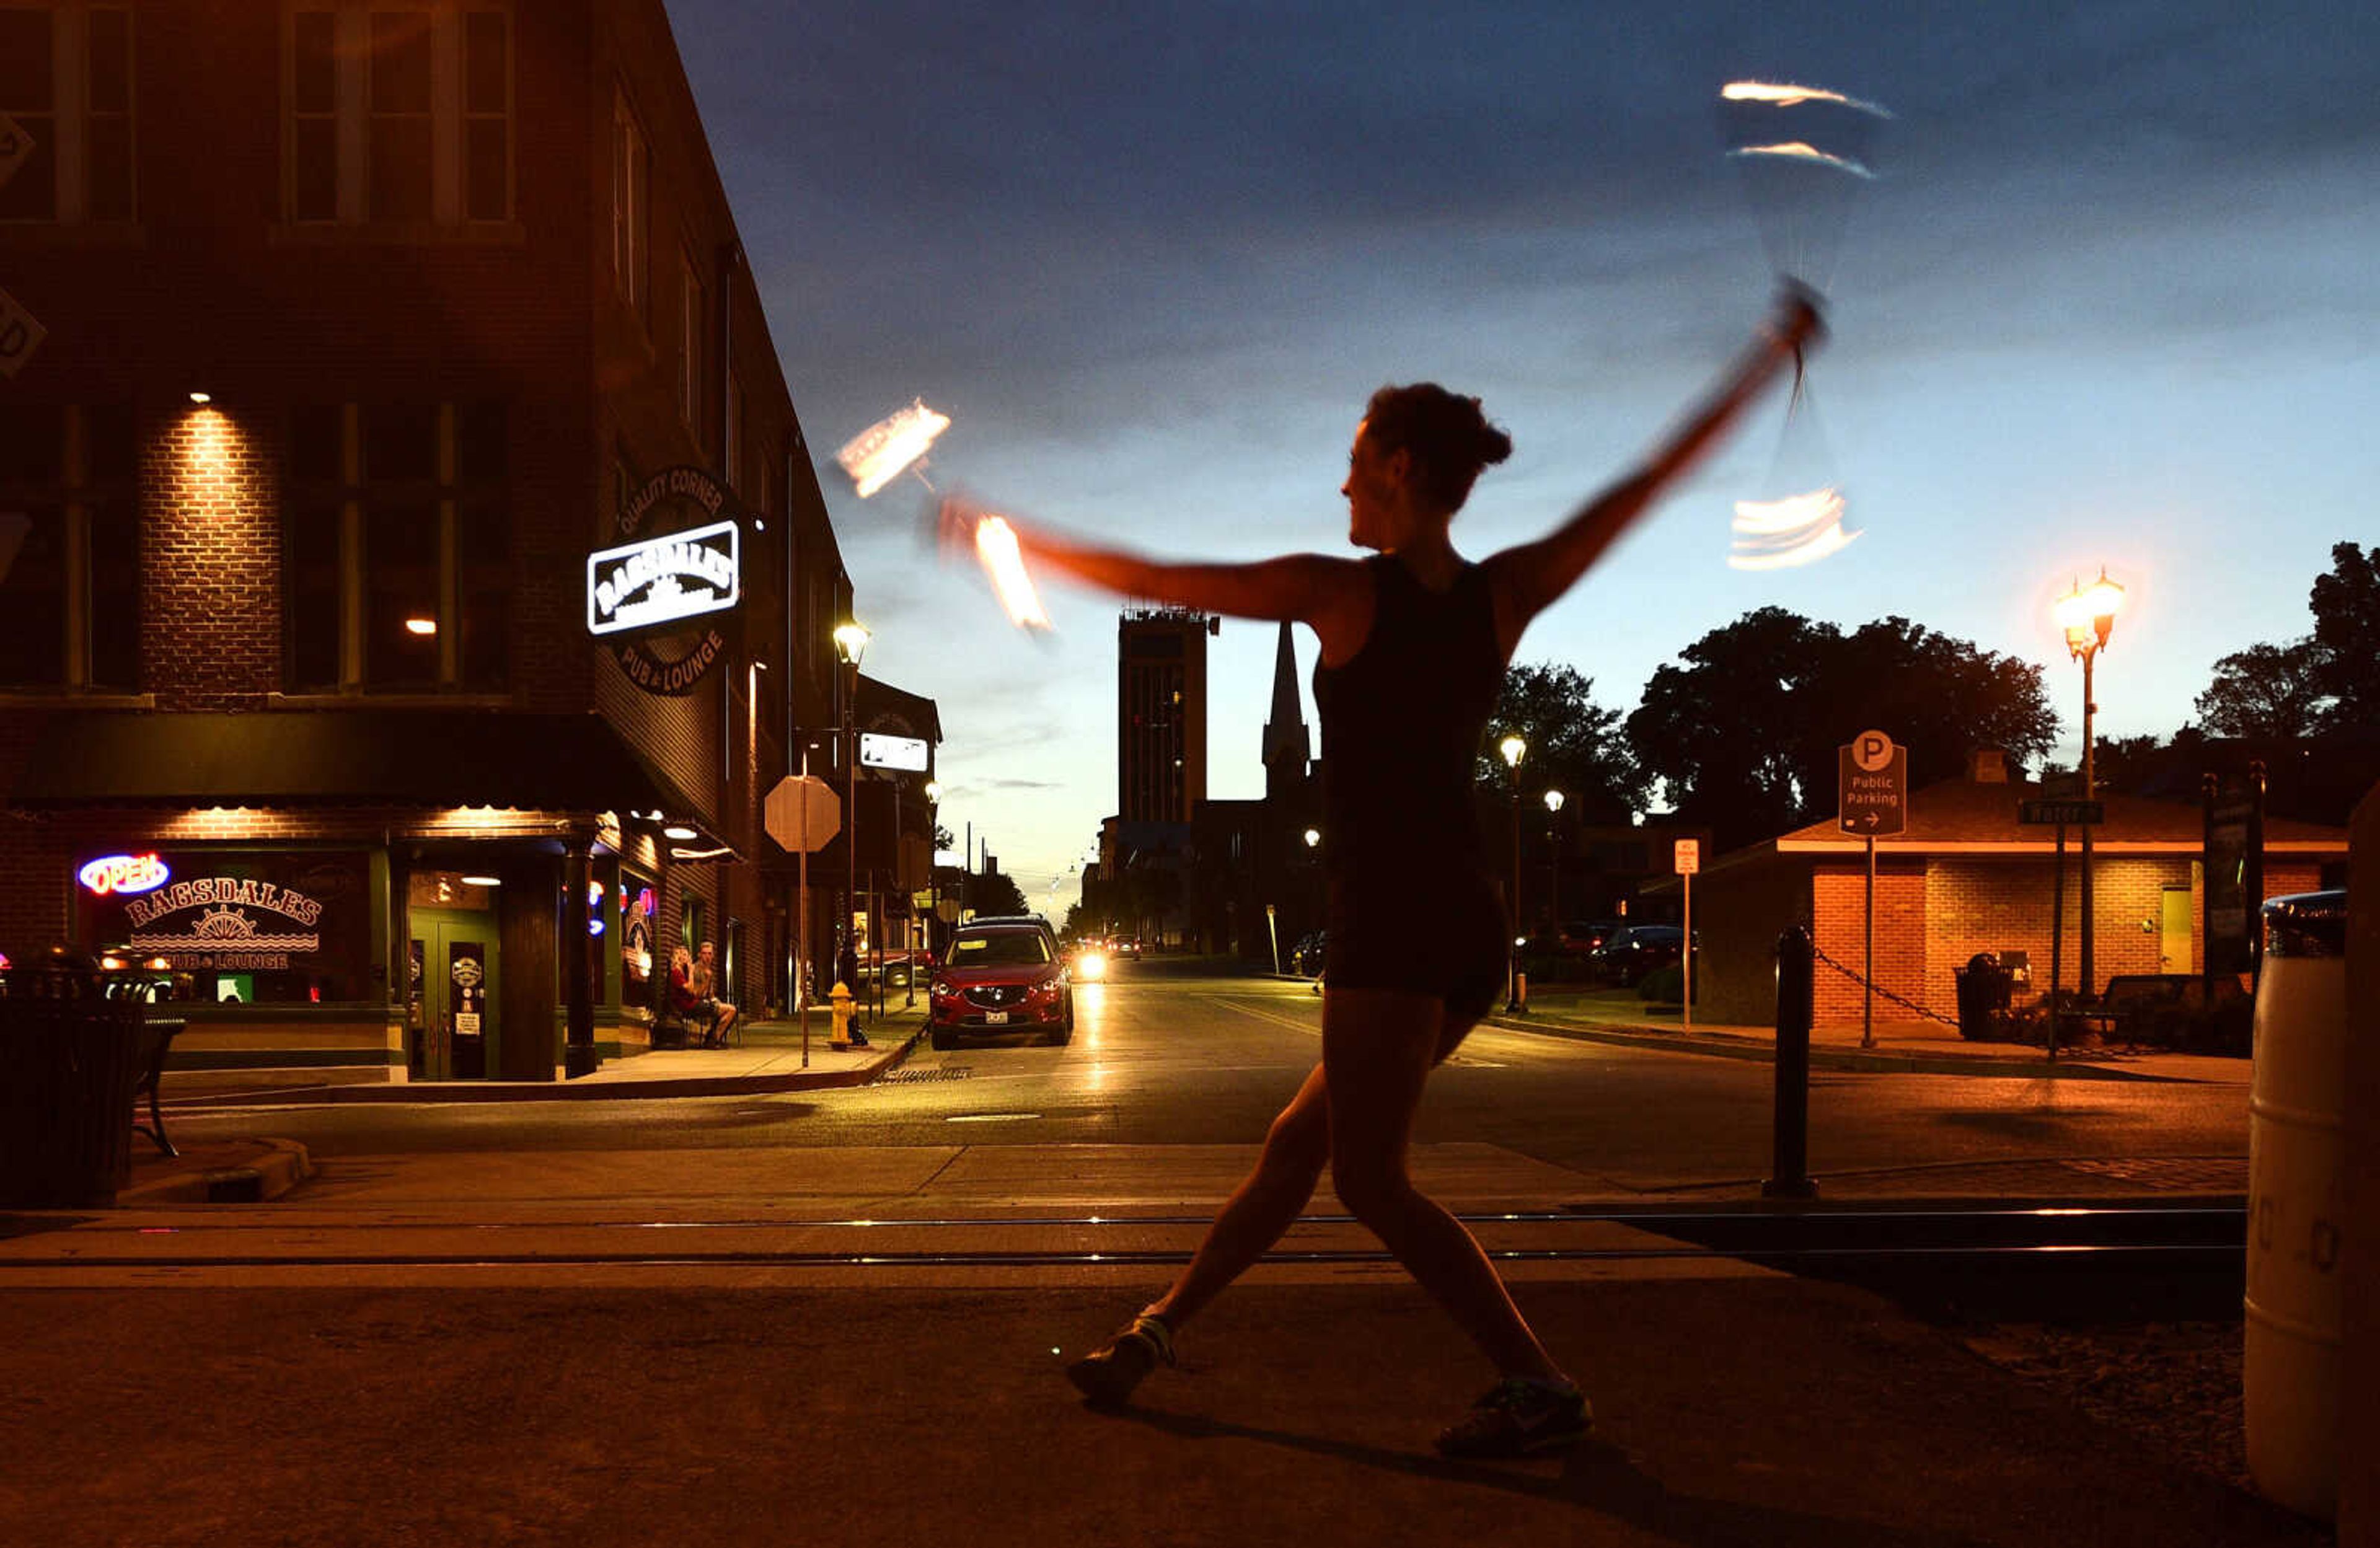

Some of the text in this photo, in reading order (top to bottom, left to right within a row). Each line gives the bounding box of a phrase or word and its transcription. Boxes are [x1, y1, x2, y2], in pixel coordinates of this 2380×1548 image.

[620, 469, 723, 534] QUALITY CORNER
[622, 646, 650, 685] PUB
[664, 630, 722, 690] LOUNGE
[1864, 737, 1884, 764] P
[1853, 776, 1893, 788] Public
[1848, 792, 1898, 807] Parking
[92, 853, 156, 894] OPEN
[125, 877, 323, 928] RAGSDALES
[214, 953, 289, 969] LOUNGE
